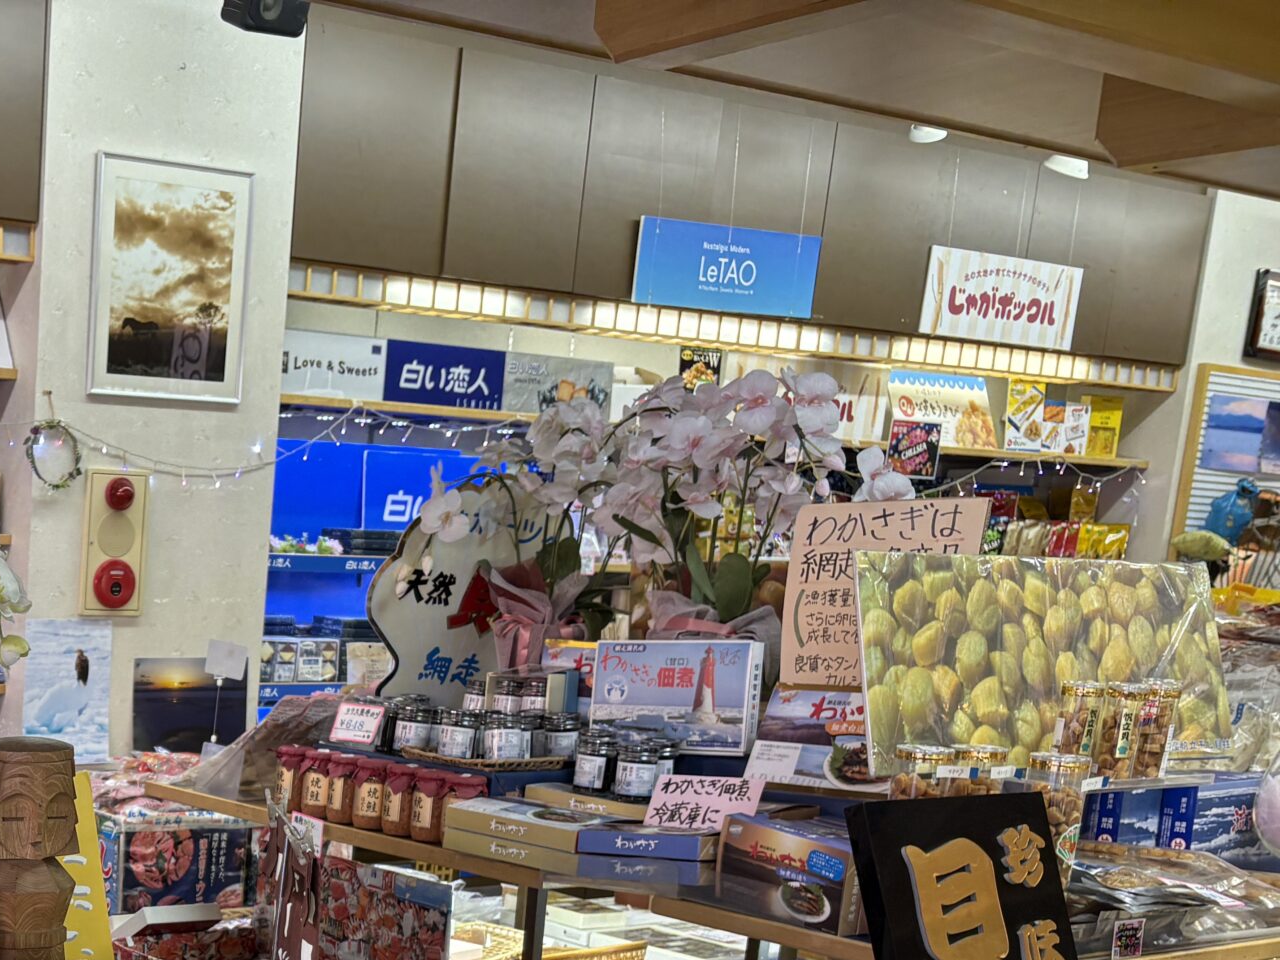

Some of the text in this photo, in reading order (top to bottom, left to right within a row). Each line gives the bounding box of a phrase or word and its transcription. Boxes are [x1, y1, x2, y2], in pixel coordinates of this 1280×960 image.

[698, 255, 757, 286] LeTAO
[947, 285, 1056, 327] じゃがポックル
[293, 356, 378, 377] Love & Sweets
[398, 359, 491, 397] 白い恋人
[805, 503, 963, 547] わかさぎは
[345, 559, 377, 571] 白い恋人
[399, 568, 457, 607] 天然
[804, 588, 856, 608] 漁獲量
[417, 647, 482, 687] 網走
[794, 654, 859, 673] 良質なタン
[339, 719, 365, 731] ¥648
[1121, 711, 1134, 742] 帆立貝
[366, 786, 380, 814] 焼鮭
[660, 777, 752, 802] わかさぎ佃煮
[649, 801, 721, 829] 冷蔵庫に
